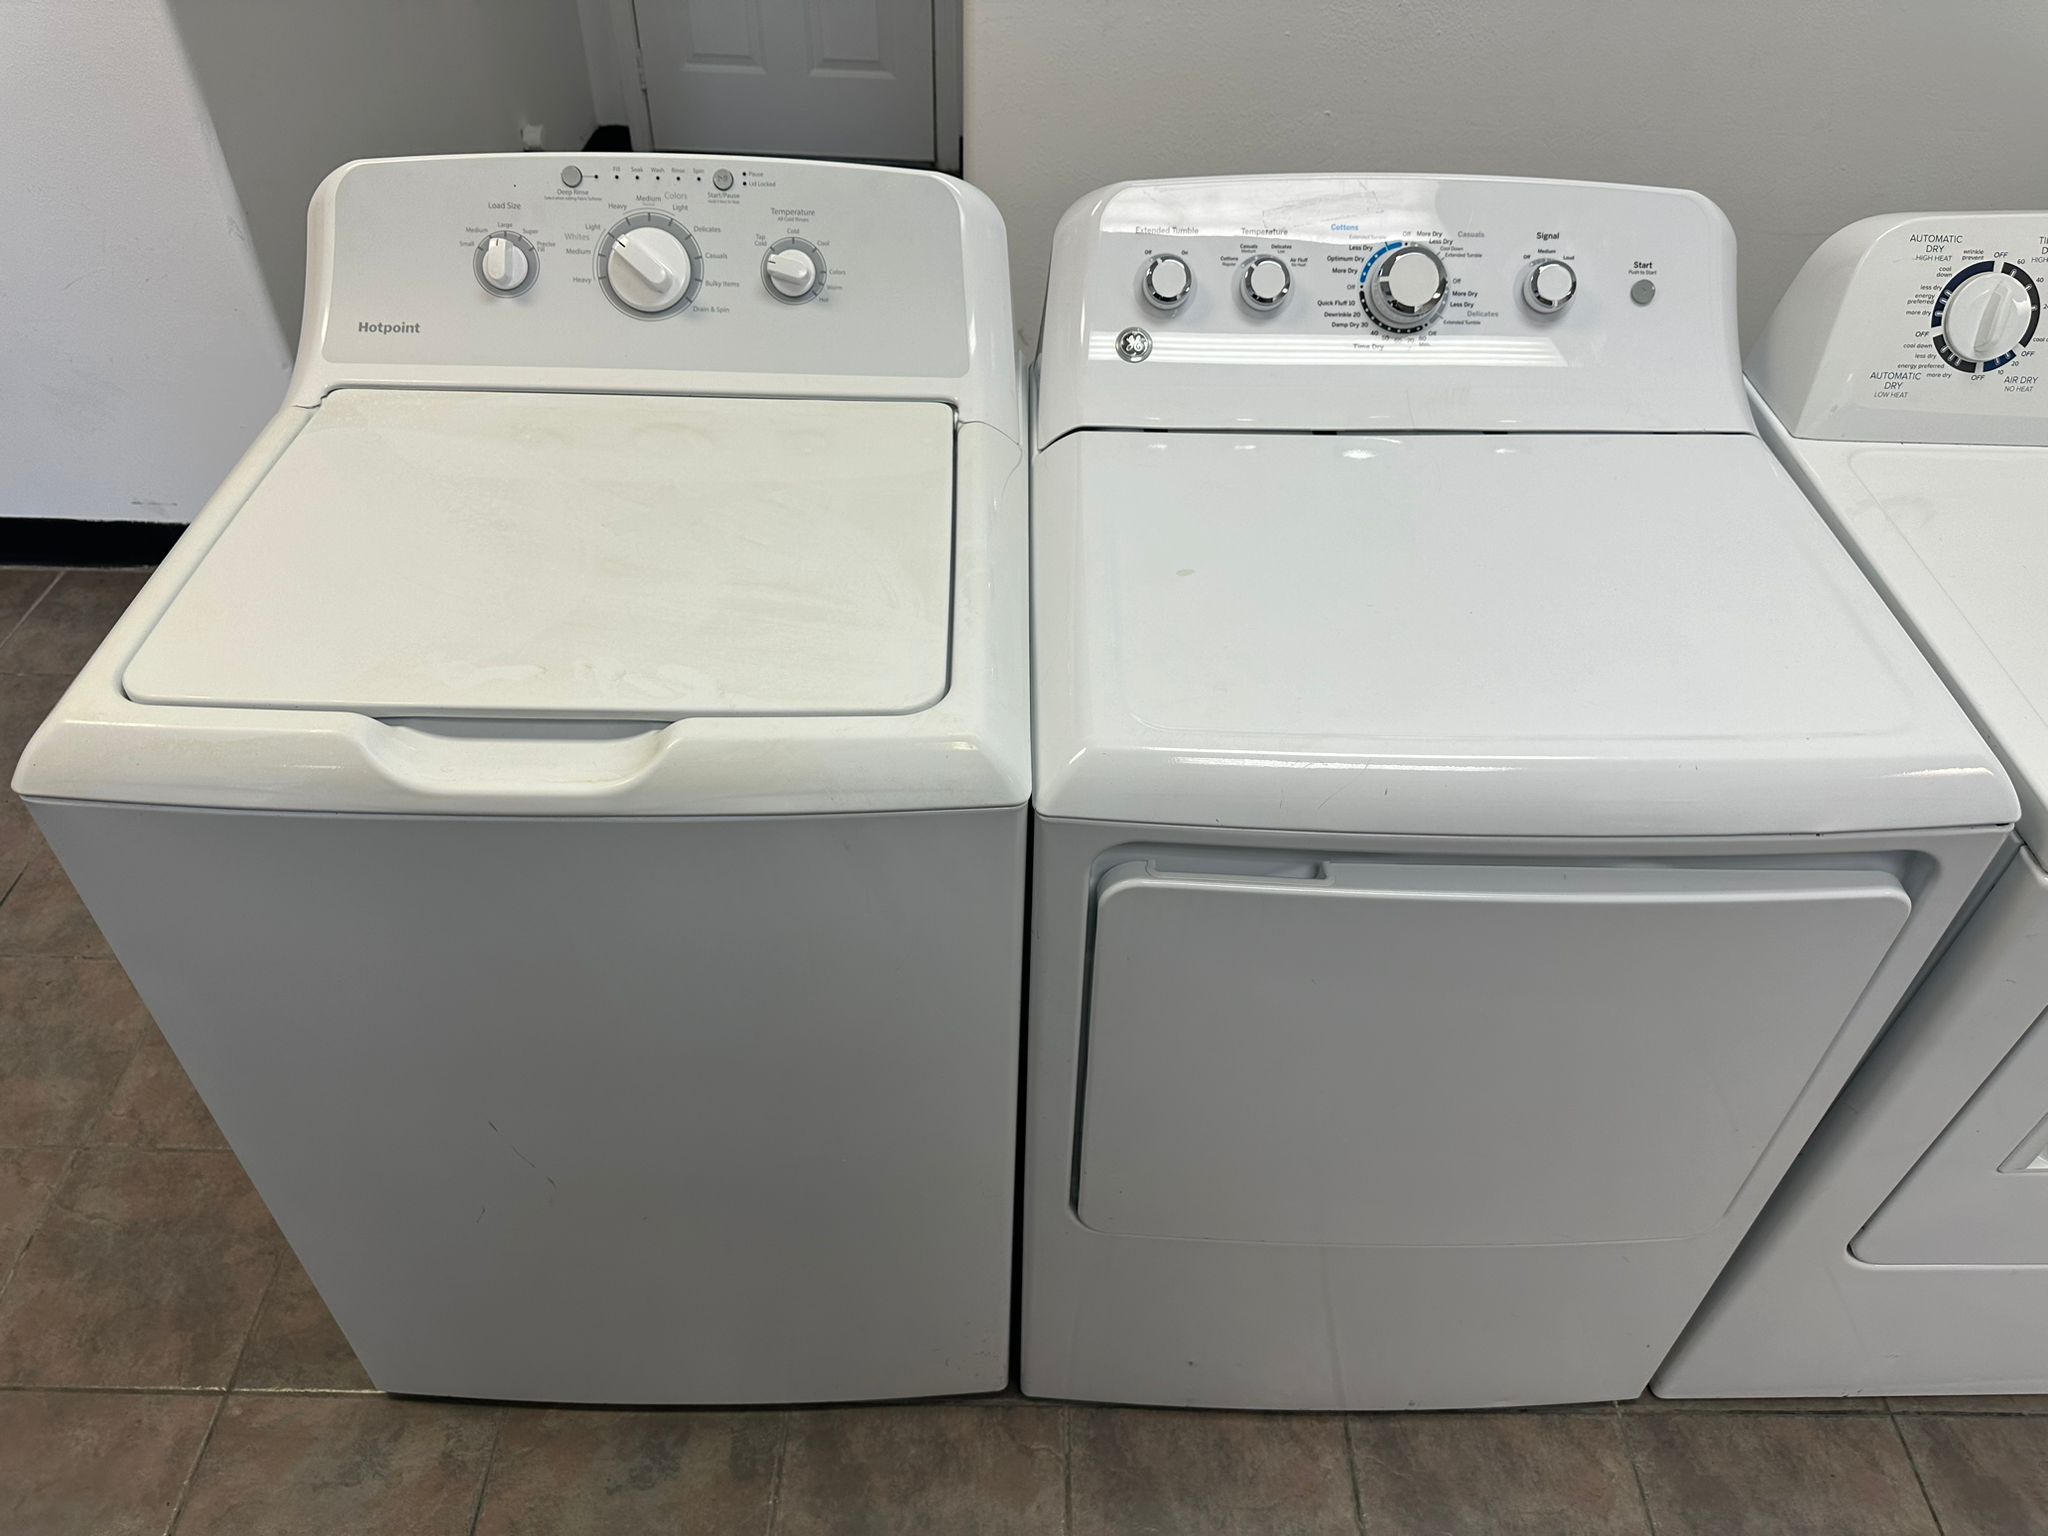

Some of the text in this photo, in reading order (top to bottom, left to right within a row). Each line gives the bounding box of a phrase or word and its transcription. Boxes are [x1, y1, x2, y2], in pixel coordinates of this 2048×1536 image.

[663, 192, 688, 200] Colors
[488, 202, 521, 210] Load Size
[608, 203, 627, 211] Heavy
[672, 204, 689, 213] Light
[771, 208, 816, 217] Temperature
[1135, 226, 1199, 235] Extended Tumble
[1330, 223, 1359, 231] Cottons
[1242, 227, 1289, 236] Temperature
[1457, 231, 1486, 239] Casuals
[564, 233, 590, 241] Whites
[1536, 231, 1560, 241] Signal
[1909, 234, 1964, 244] AUTOMATIC
[1925, 245, 1945, 253] DRY
[705, 252, 728, 260] Casuals
[1327, 255, 1365, 263] Optimum Dry
[1993, 251, 2009, 259] OFF
[1633, 261, 1653, 269] Start
[717, 306, 730, 315] Spin
[1467, 310, 1499, 318] Delicates
[358, 321, 421, 335] Hotpoint
[1870, 371, 1922, 381] AUTOMATIC
[2003, 376, 2039, 384] AIR DRY
[1884, 382, 1903, 390] DRY
[1890, 391, 1909, 399] HEAT
